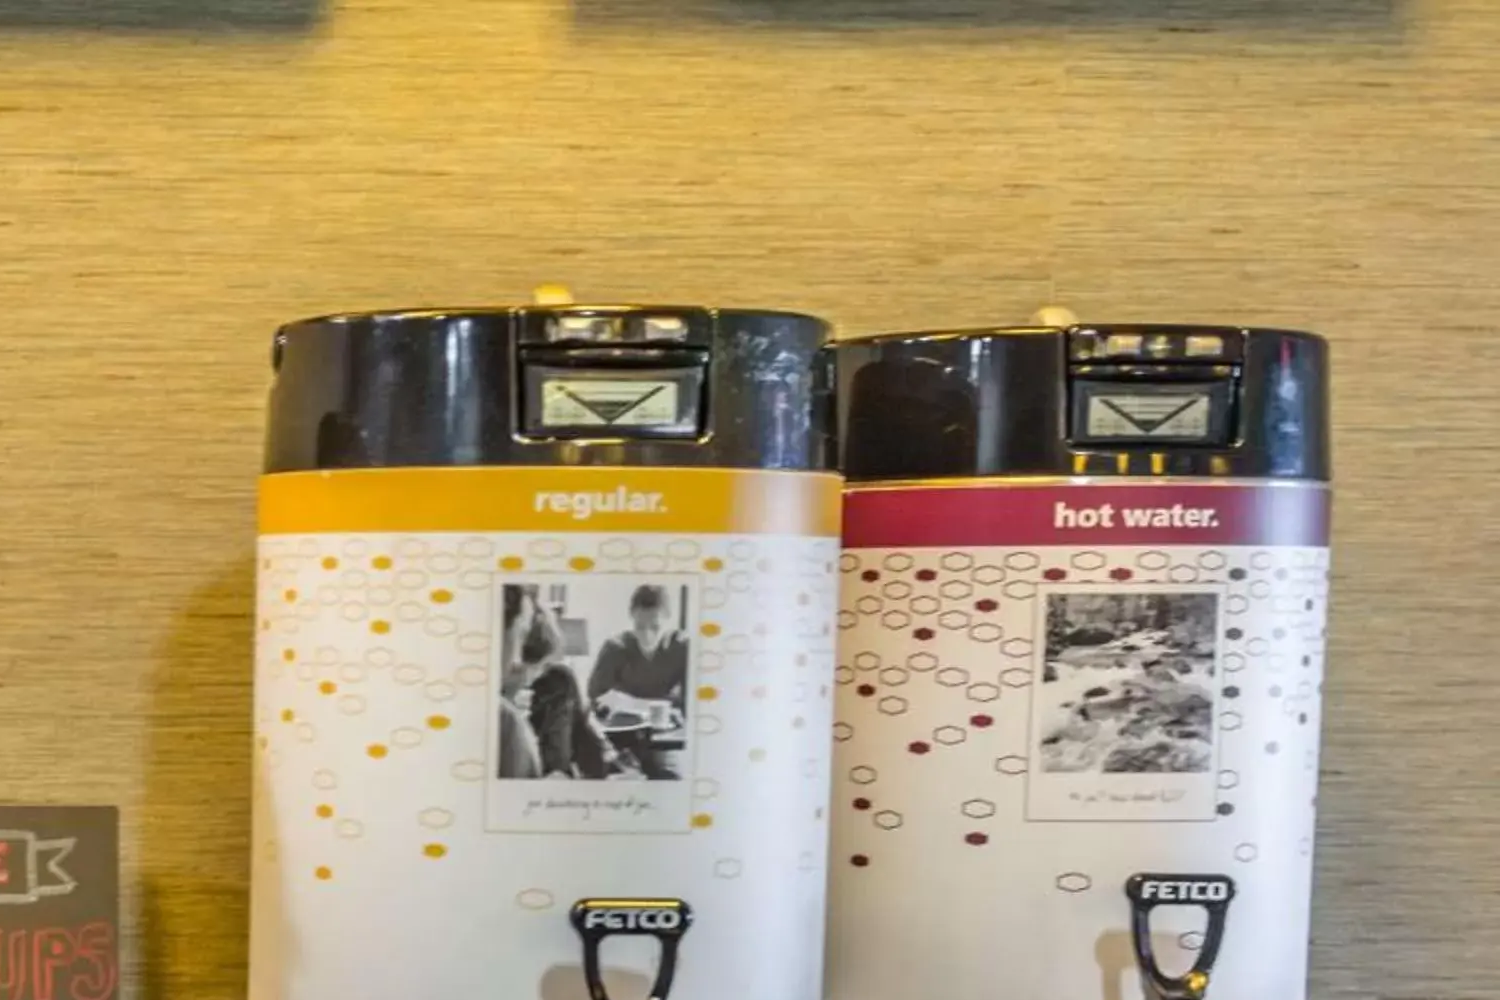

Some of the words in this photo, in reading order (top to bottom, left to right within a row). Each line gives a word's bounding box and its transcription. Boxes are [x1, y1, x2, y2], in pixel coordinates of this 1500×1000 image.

[535, 485, 668, 519] regular.
[1054, 501, 1115, 528] hot
[1122, 503, 1219, 528] water.
[1141, 881, 1228, 901] FETCO
[584, 910, 681, 930] FETCO
